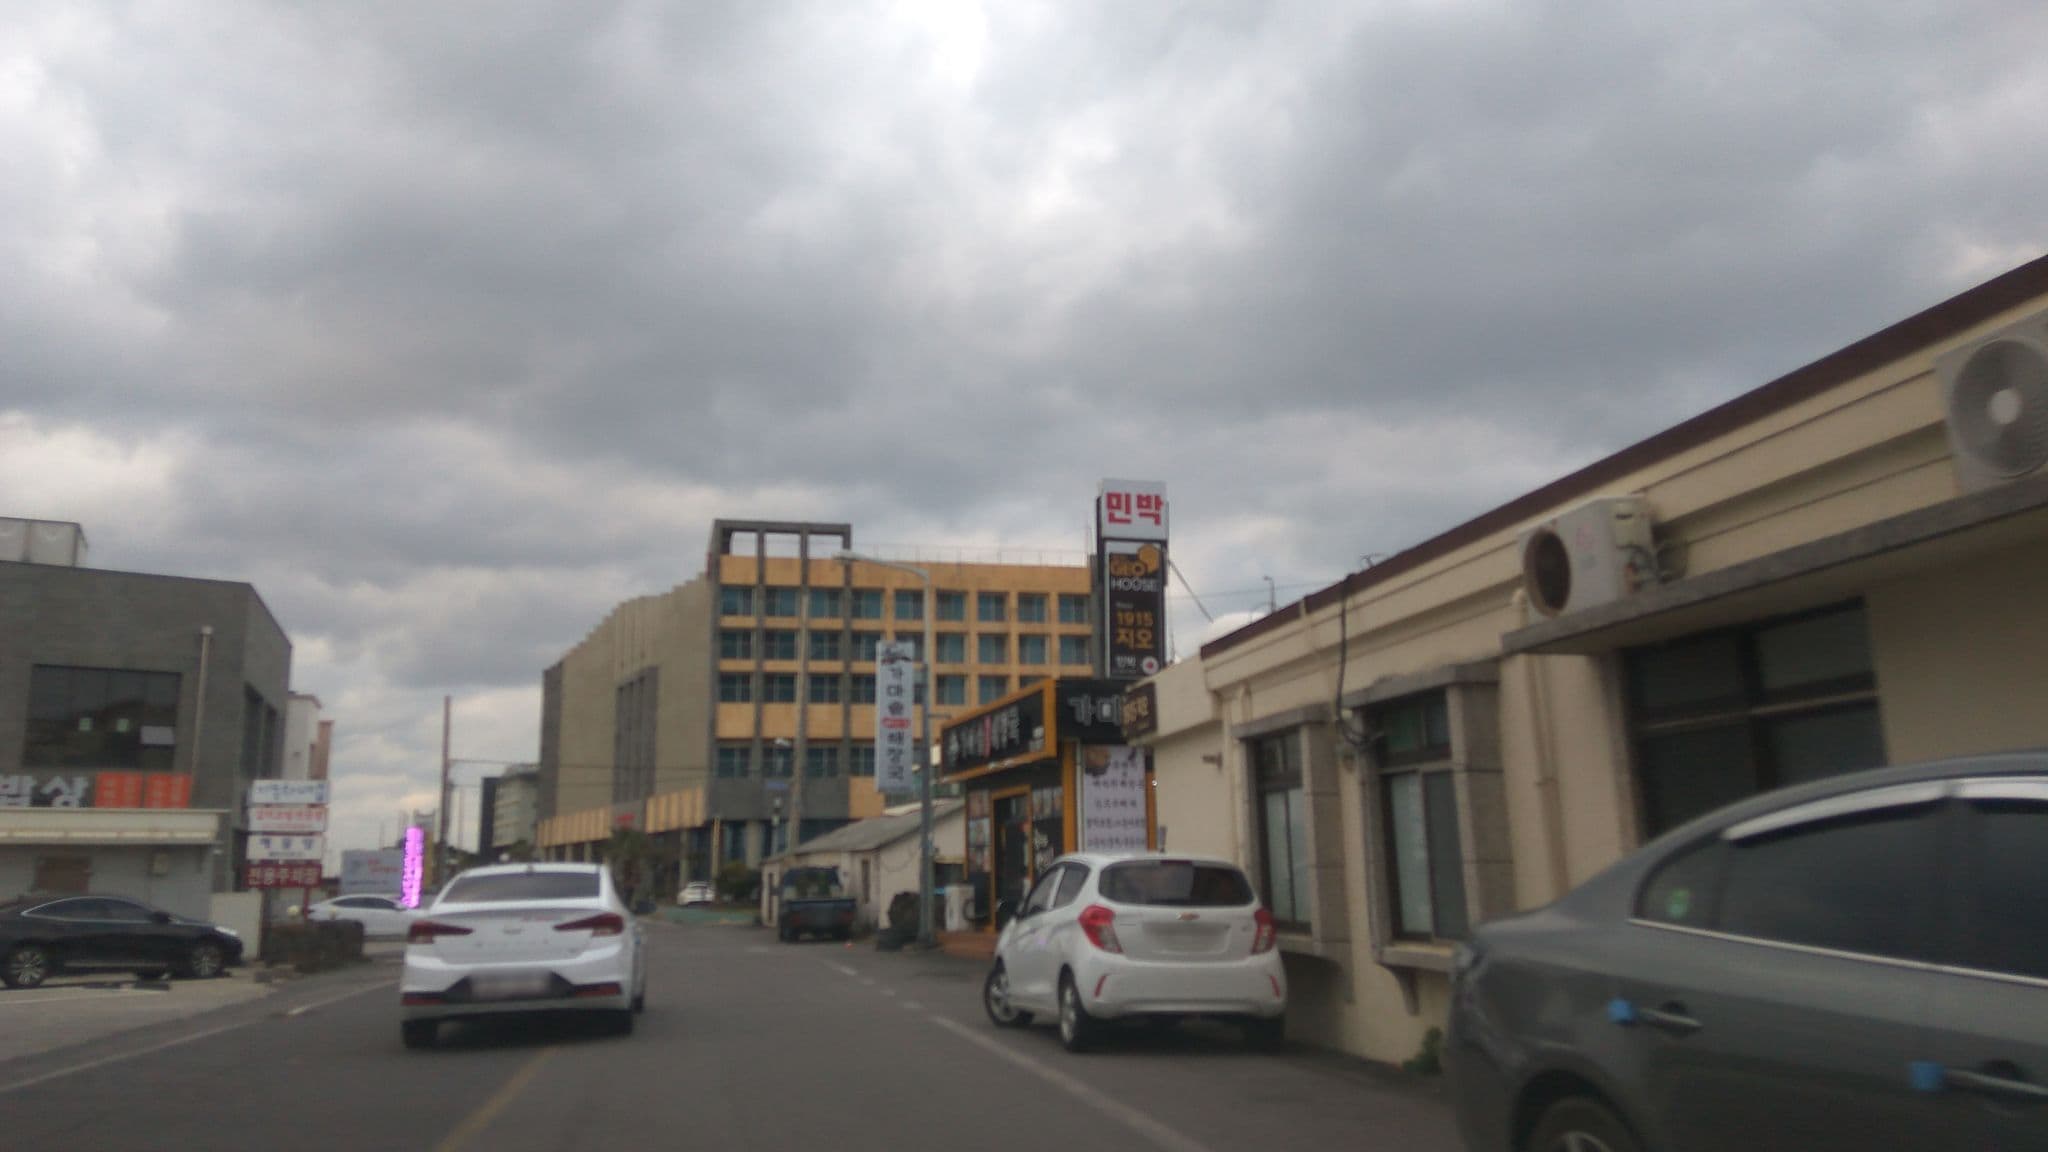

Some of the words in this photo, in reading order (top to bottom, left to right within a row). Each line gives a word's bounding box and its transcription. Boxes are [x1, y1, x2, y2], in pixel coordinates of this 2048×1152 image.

[1106, 492, 1164, 526] 민박
[1116, 611, 1154, 626] 1915
[1116, 627, 1155, 649] 지오
